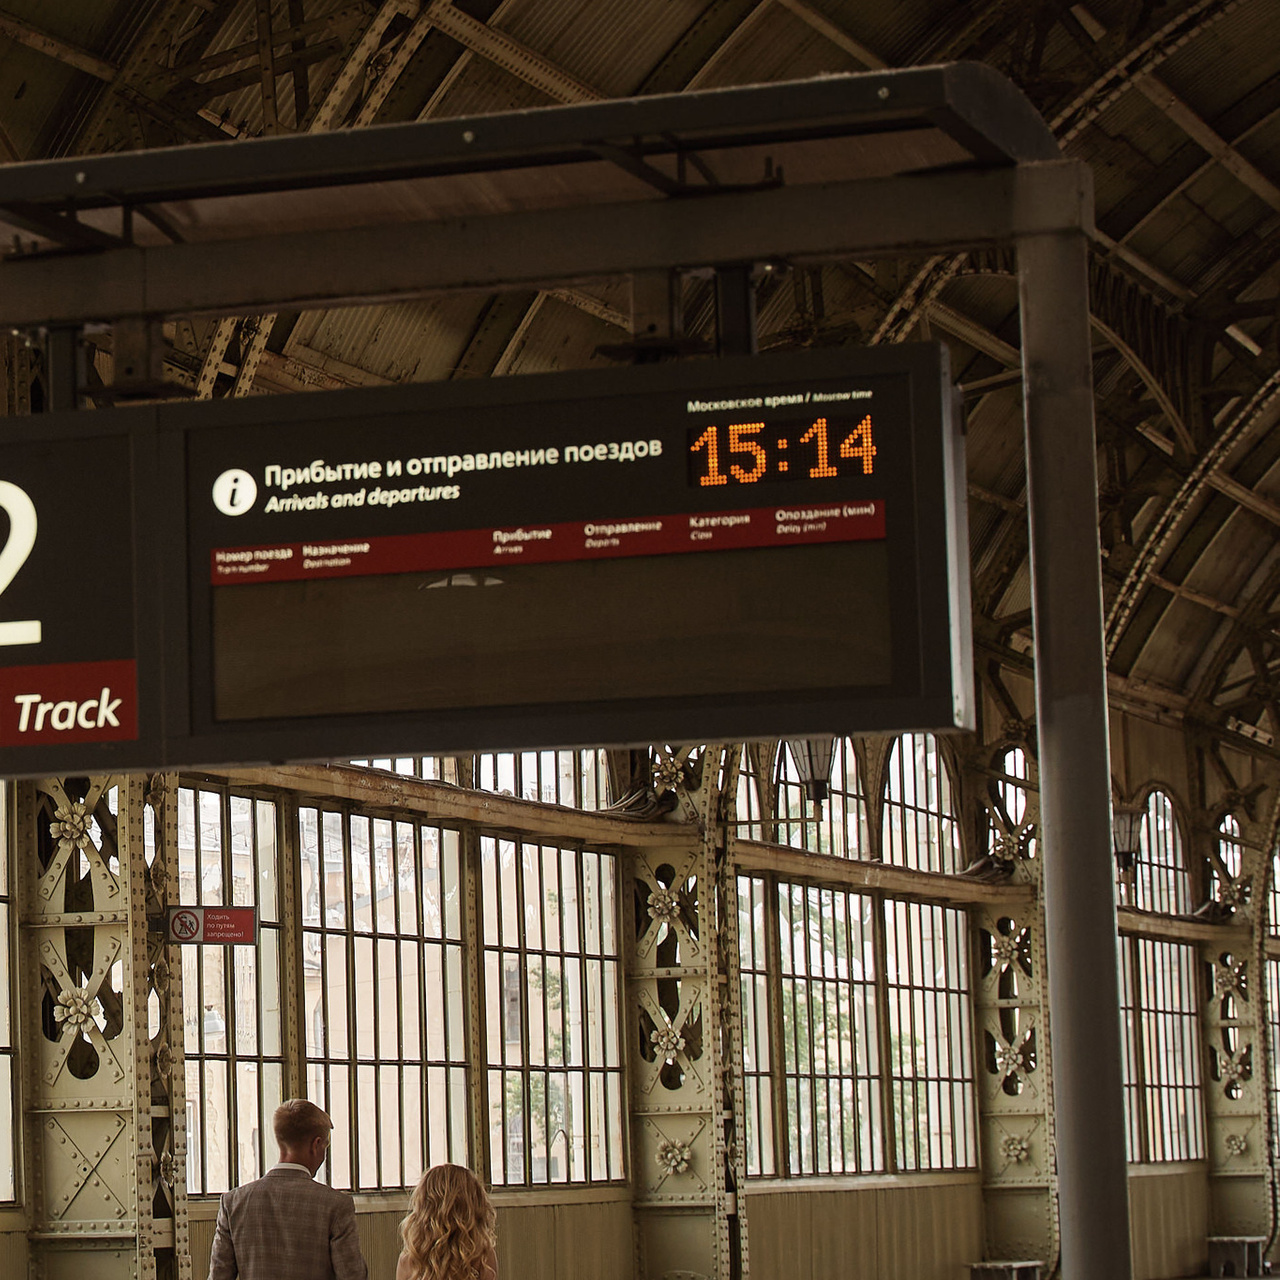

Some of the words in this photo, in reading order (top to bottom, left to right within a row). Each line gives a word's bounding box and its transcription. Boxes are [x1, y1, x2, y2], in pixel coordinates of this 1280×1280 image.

[687, 396, 763, 413] Московское
[765, 394, 804, 409] время
[812, 392, 851, 403] Moscow
[852, 390, 873, 400] time
[690, 414, 877, 486] 15:14
[264, 459, 382, 491] Прибытие
[386, 459, 402, 477] и
[406, 447, 559, 478] отправление
[564, 439, 663, 463] поездов
[264, 491, 329, 514] Arrivals
[331, 488, 366, 508] and
[367, 485, 461, 508] departures
[689, 514, 751, 529] Категория
[775, 506, 841, 522] Опоздание
[843, 503, 876, 518] (мин)
[492, 528, 552, 545] Прибытие
[584, 521, 663, 536] Отправление
[215, 550, 253, 563] Номер
[253, 548, 294, 561] поезда
[302, 542, 371, 557] Назначение
[14, 687, 123, 733] Track
[206, 931, 244, 939] запрещено!
